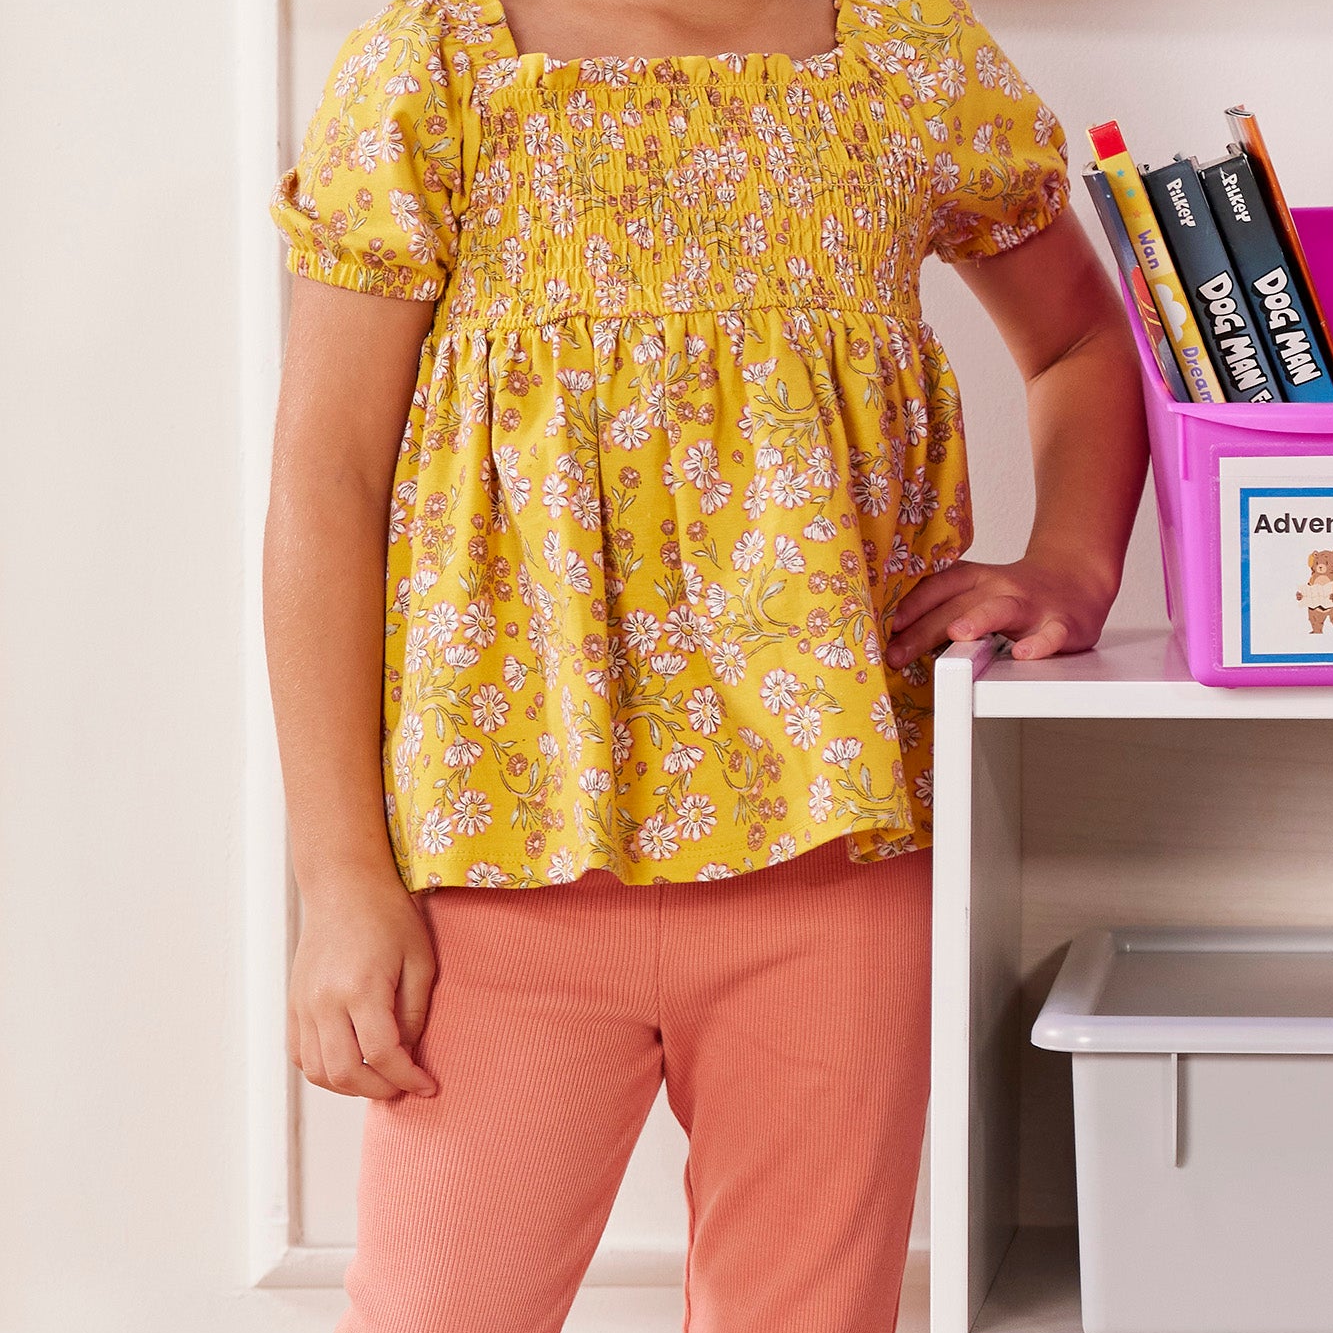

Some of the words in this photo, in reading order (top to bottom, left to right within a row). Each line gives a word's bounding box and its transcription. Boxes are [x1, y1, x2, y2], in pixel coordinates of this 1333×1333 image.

[1138, 229, 1160, 270] Wan
[1198, 271, 1246, 335] DOG
[1253, 266, 1300, 330] DOG
[1220, 336, 1267, 391] MAN
[1275, 330, 1322, 386] MAN
